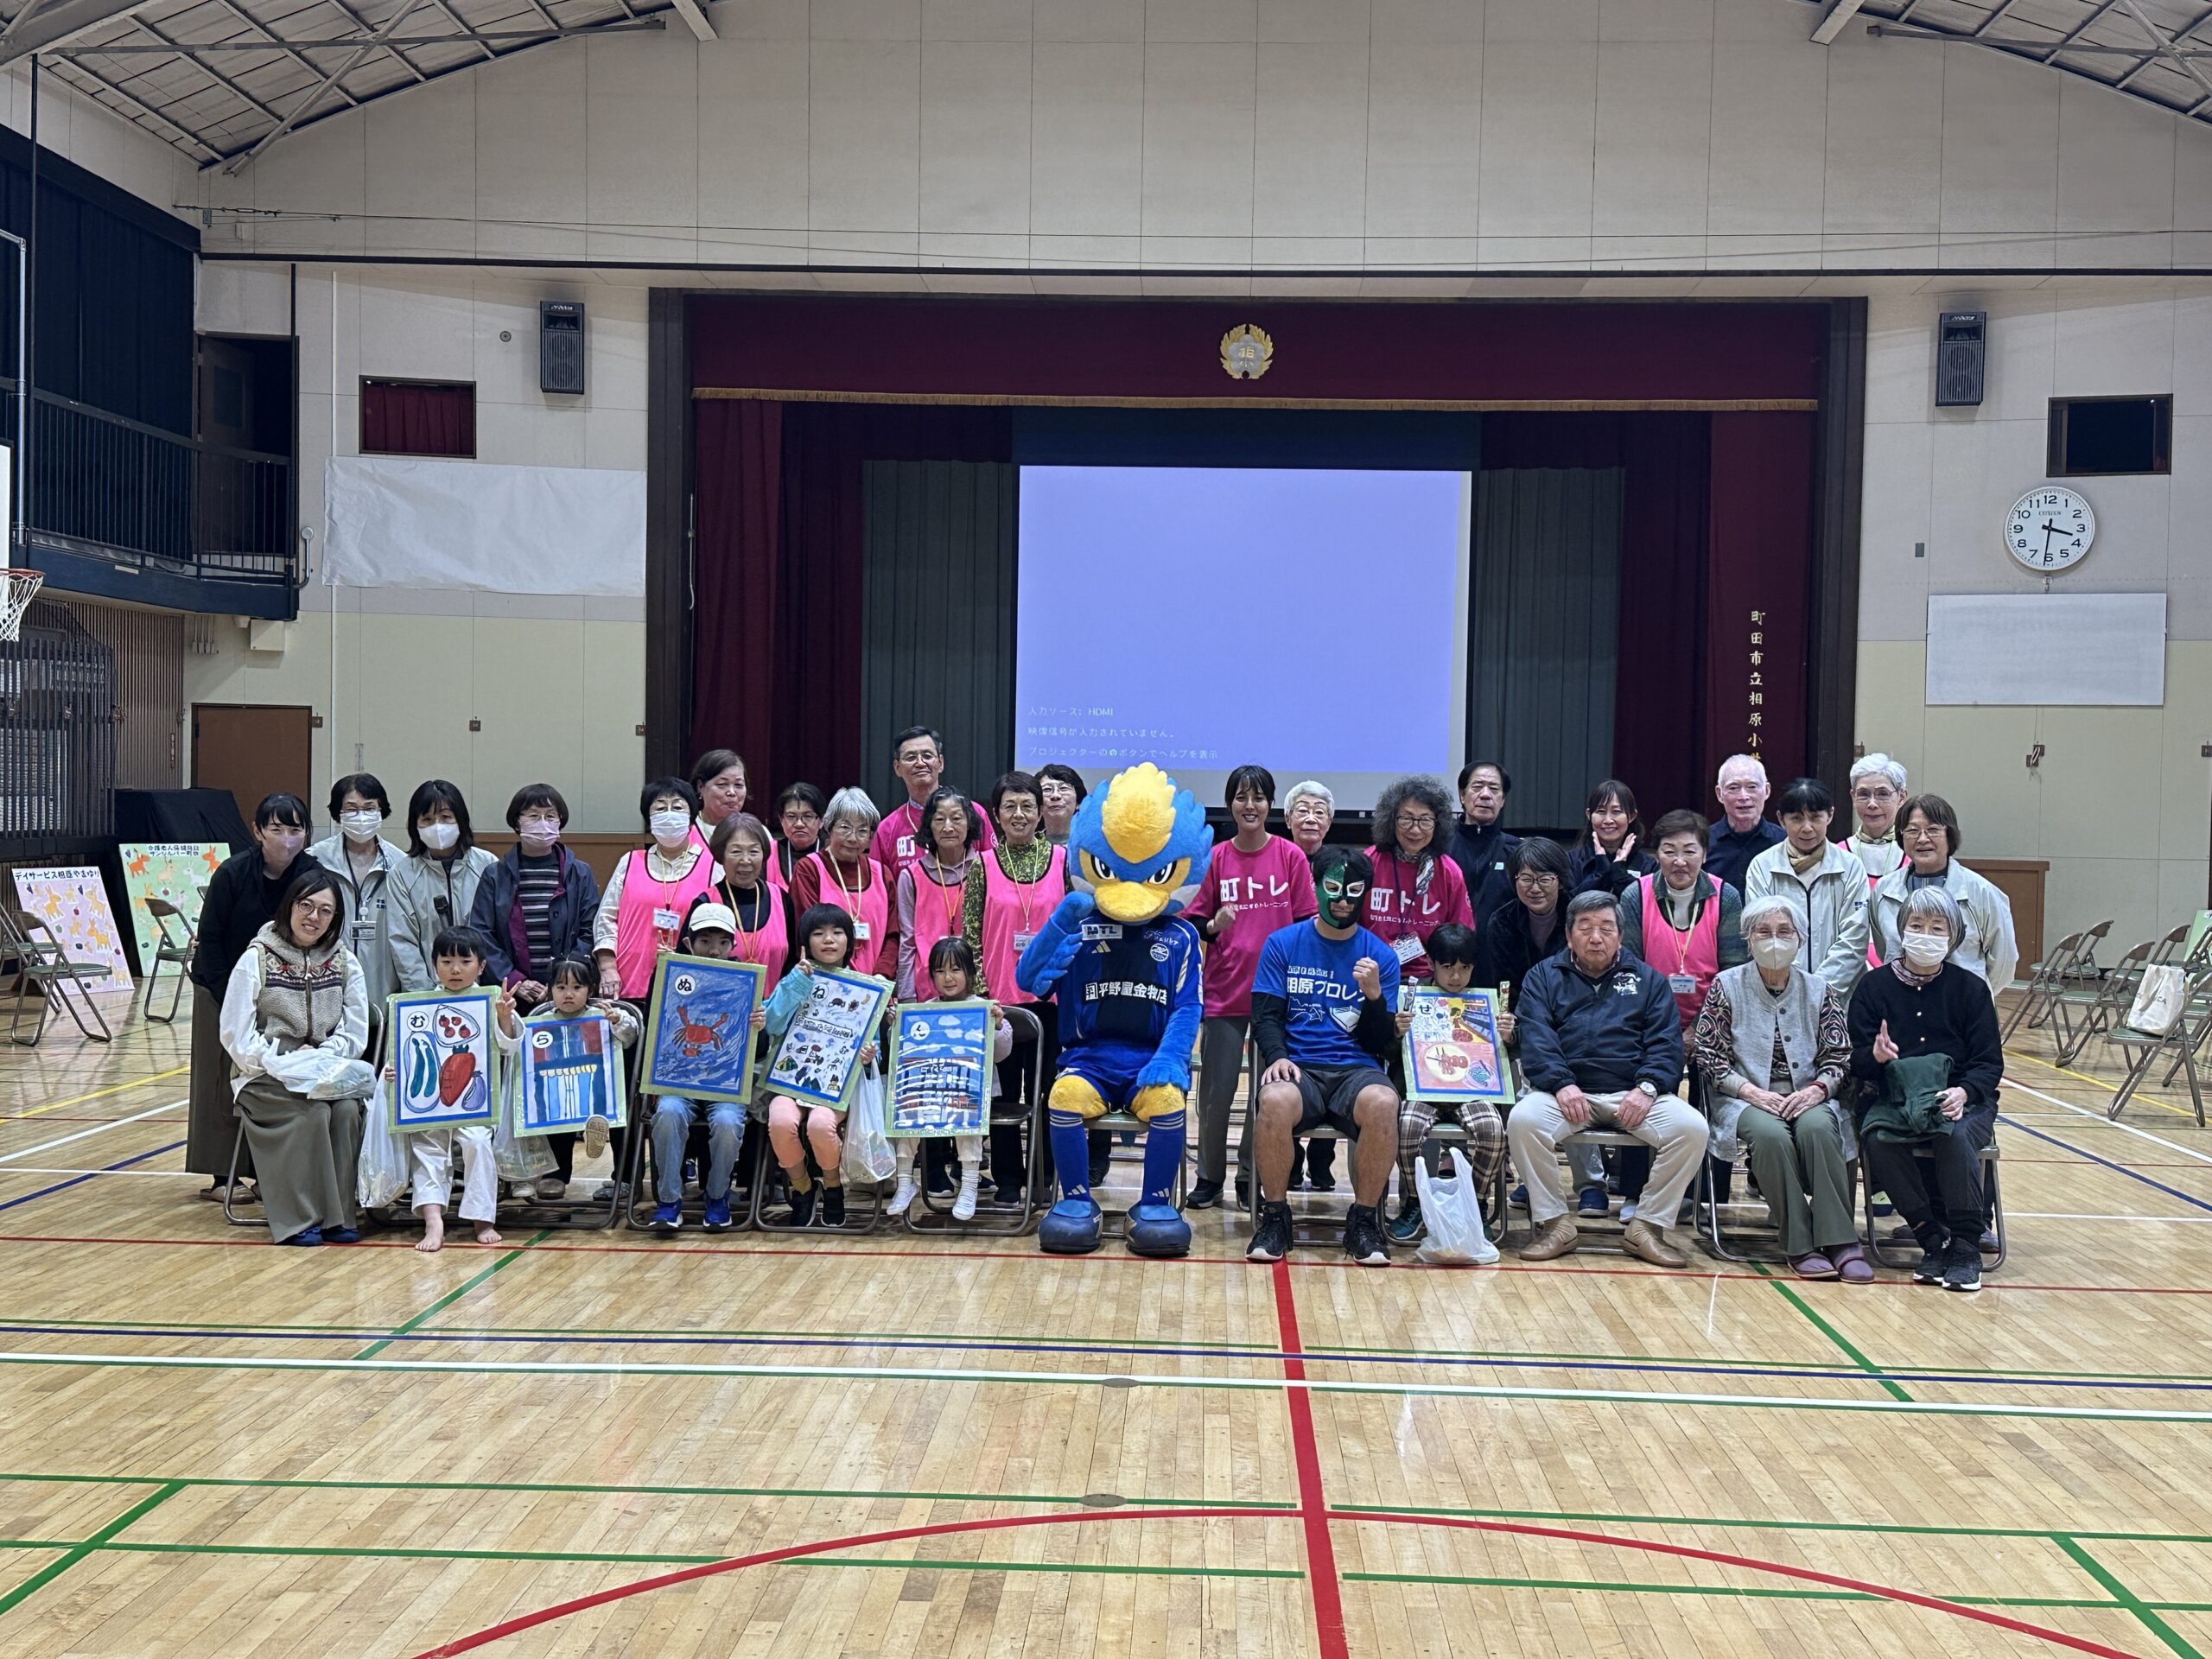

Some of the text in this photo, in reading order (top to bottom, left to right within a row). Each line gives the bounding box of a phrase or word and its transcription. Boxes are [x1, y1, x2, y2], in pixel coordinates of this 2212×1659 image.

[2029, 499, 2040, 508] 11
[2044, 495, 2057, 505] 12
[2064, 499, 2069, 508] 1
[2018, 510, 2031, 519] 10
[2072, 510, 2082, 518] 2
[2013, 524, 2024, 534] 9
[2076, 524, 2086, 533] 3
[2018, 539, 2027, 548] 8
[2071, 538, 2082, 548] 4
[2029, 550, 2038, 559] 7
[2044, 553, 2054, 563] 6
[2060, 549, 2069, 558] 5
[1088, 708, 1114, 716] HDMI
[1219, 874, 1289, 902] 町トレ
[1370, 887, 1441, 915] 町トレ
[677, 978, 692, 992] ぬ
[812, 985, 826, 1000] ね
[1418, 1004, 1433, 1014] せ
[410, 1014, 426, 1028] む
[537, 1034, 550, 1046] ら
